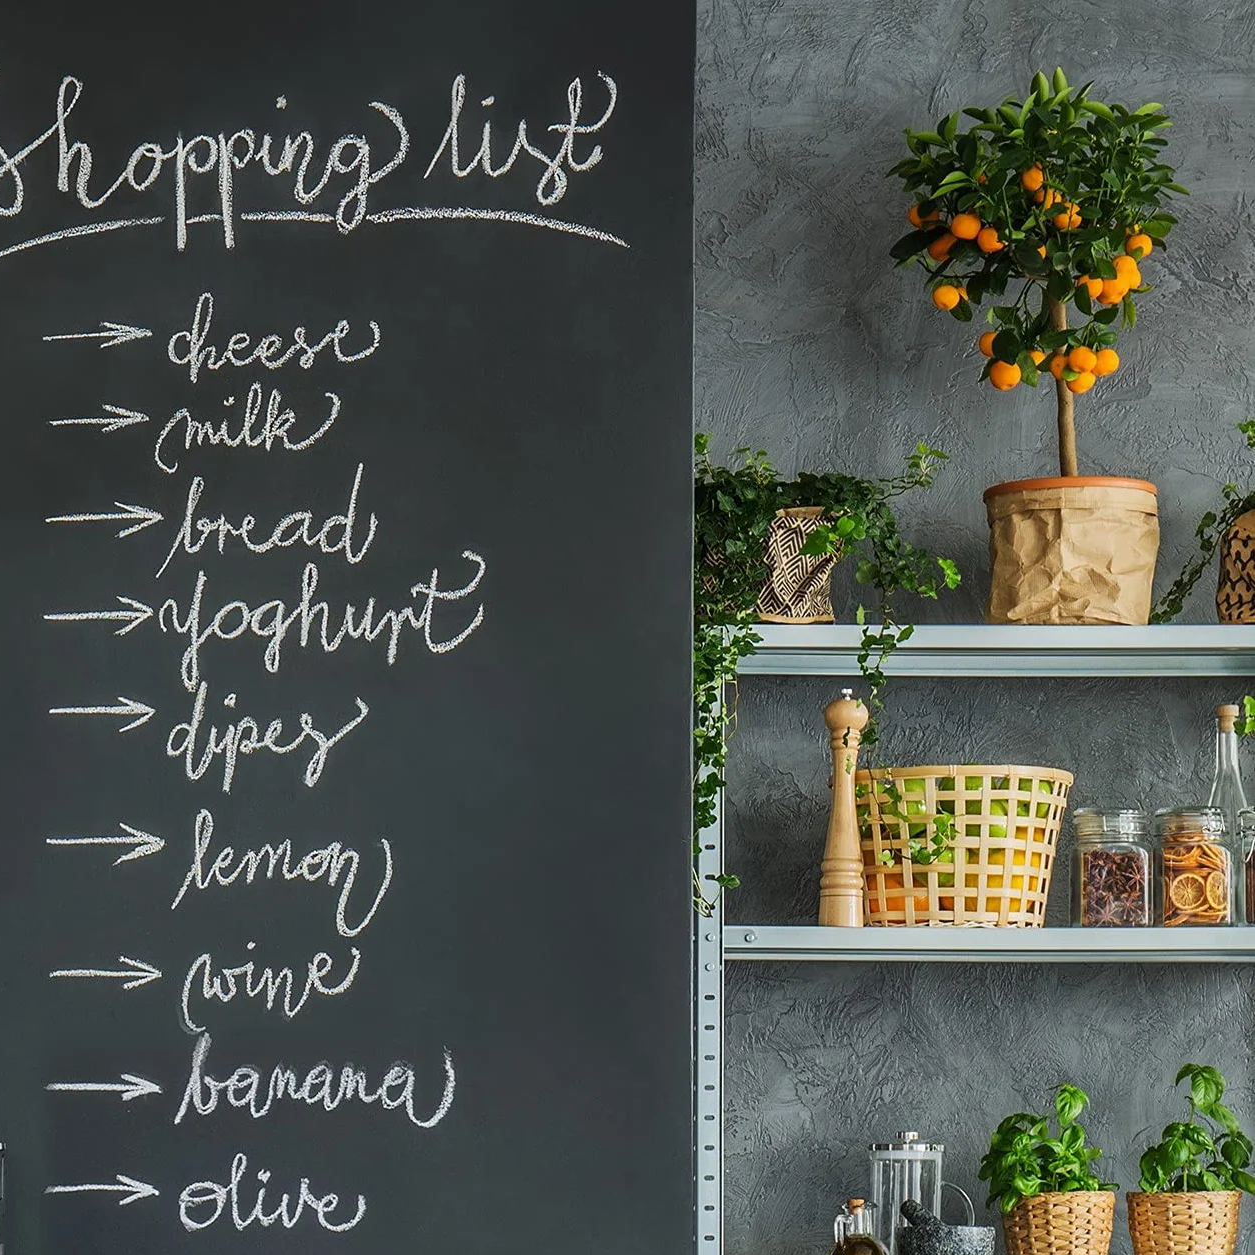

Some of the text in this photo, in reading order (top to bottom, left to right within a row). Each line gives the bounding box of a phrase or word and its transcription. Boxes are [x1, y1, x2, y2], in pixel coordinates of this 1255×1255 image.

[425, 72, 618, 207] list
[169, 294, 381, 384] cheese
[156, 382, 342, 475] milk
[157, 464, 379, 579] bread
[172, 810, 394, 938] lemon
[182, 942, 361, 1032] wine
[175, 1033, 457, 1128] banana
[180, 1154, 367, 1233] olive
